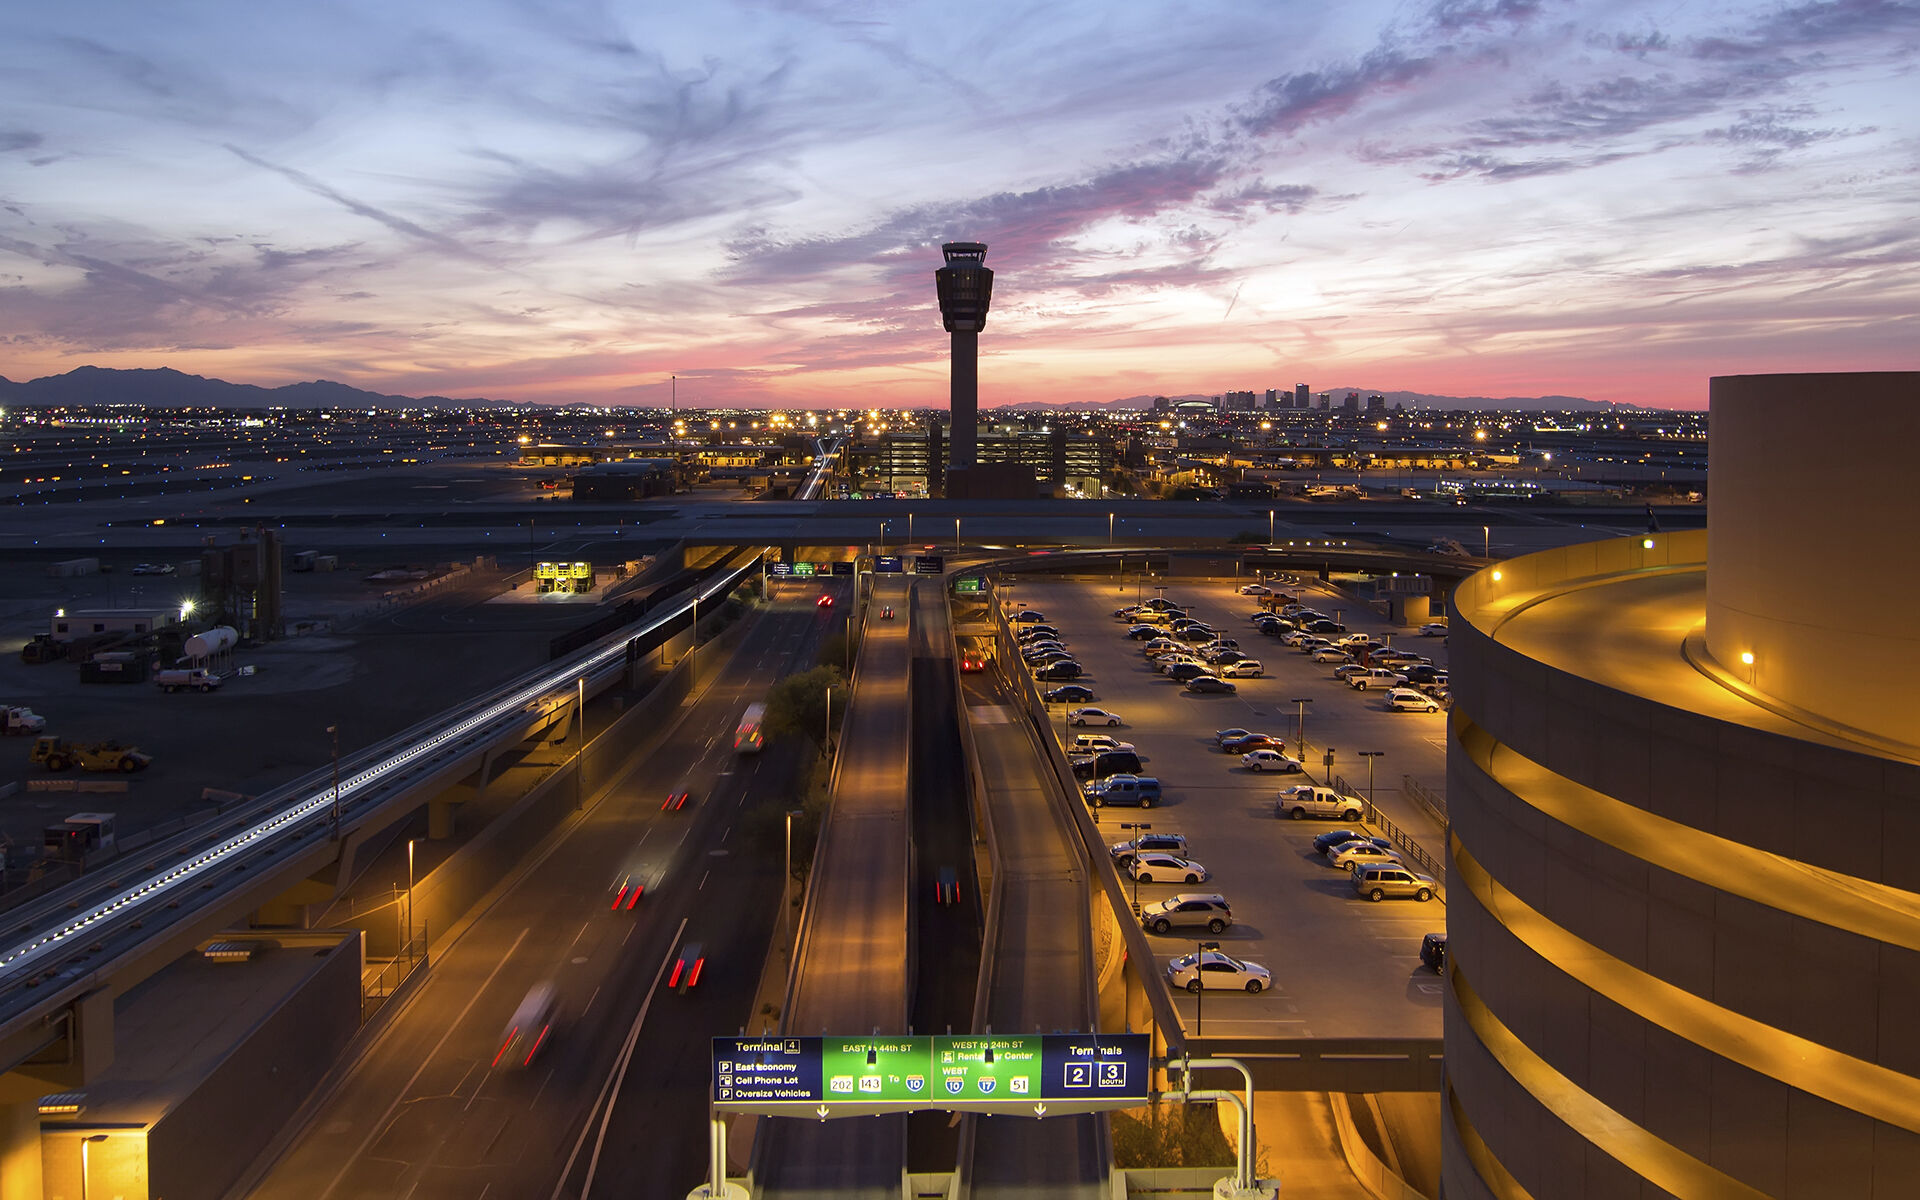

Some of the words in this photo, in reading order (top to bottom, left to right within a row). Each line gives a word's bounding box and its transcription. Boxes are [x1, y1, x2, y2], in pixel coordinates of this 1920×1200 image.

[736, 1042, 783, 1051] Terminal
[789, 1041, 795, 1049] 4
[843, 1044, 866, 1052] EAST
[880, 1044, 898, 1052] 44th
[901, 1044, 912, 1052] ST
[1070, 1046, 1122, 1055] Termnals
[1004, 1052, 1033, 1060] Center
[735, 1063, 754, 1071] East
[942, 1067, 968, 1075] WEST
[1073, 1068, 1083, 1082] 2
[1107, 1065, 1118, 1079] 3
[832, 1081, 852, 1090] 202
[861, 1079, 880, 1089] 143
[888, 1075, 900, 1083] To
[910, 1080, 920, 1088] 10
[949, 1082, 960, 1090] 10
[982, 1082, 992, 1090] 17
[1013, 1080, 1026, 1090] 51
[735, 1090, 773, 1098] Oversize
[775, 1090, 811, 1098] Vehicles
